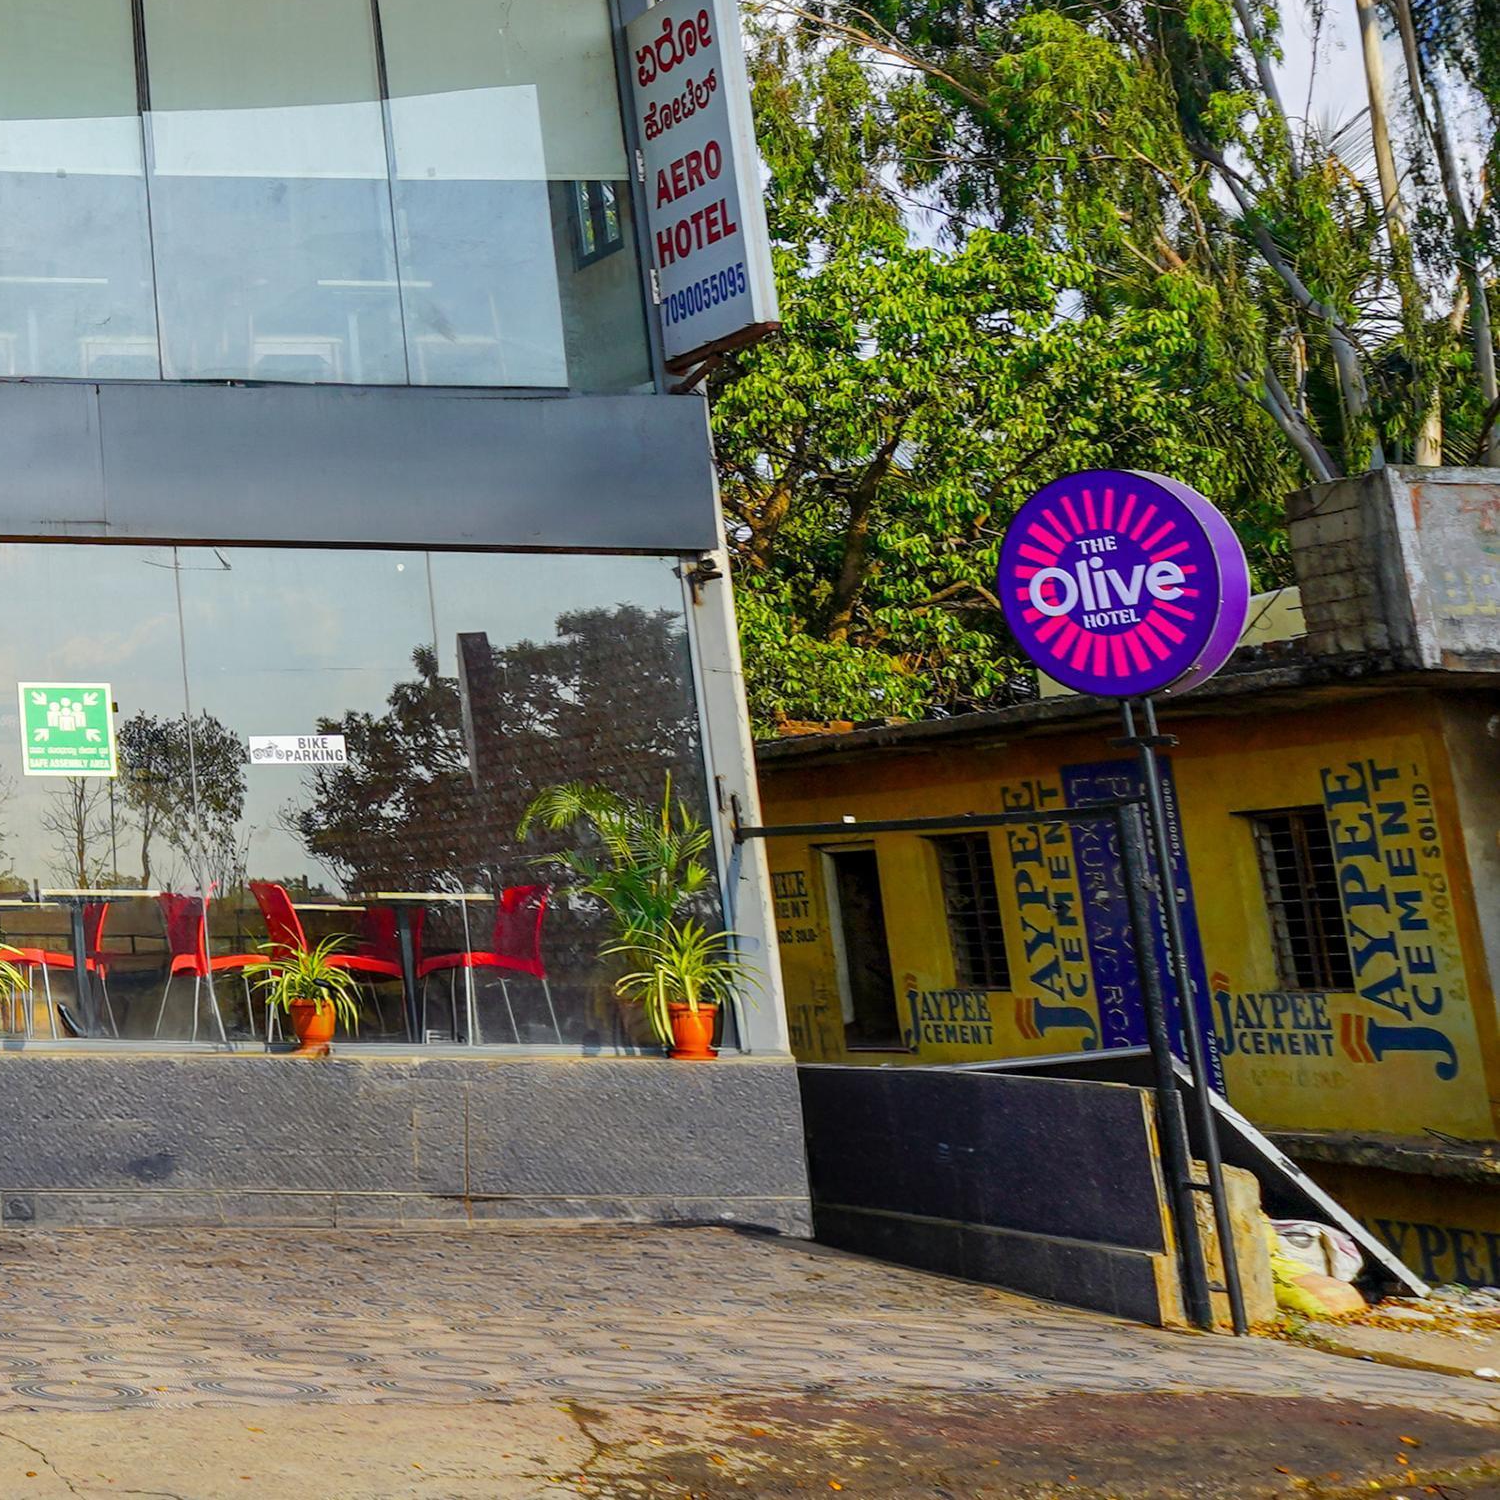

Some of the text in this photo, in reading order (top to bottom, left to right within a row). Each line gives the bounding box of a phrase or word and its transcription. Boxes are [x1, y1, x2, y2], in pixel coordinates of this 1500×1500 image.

[656, 140, 722, 210] AERO
[656, 198, 737, 269] HOTEL
[662, 262, 746, 327] 7090055095
[1076, 535, 1117, 555] THE
[1028, 556, 1186, 617] Olive
[1082, 608, 1141, 629] HOTEL
[285, 748, 344, 761] PARKING
[297, 737, 328, 749] BIKE
[1002, 780, 1100, 1051] JAYPEE
[1036, 779, 1091, 998] CEMENT
[1367, 758, 1443, 1016] CEMENT
[1320, 760, 1459, 1081] JAYPEE
[923, 1023, 995, 1046] CEMENT
[1214, 989, 1333, 1056] JAYPEE
[1238, 1031, 1335, 1057] CEMENT
